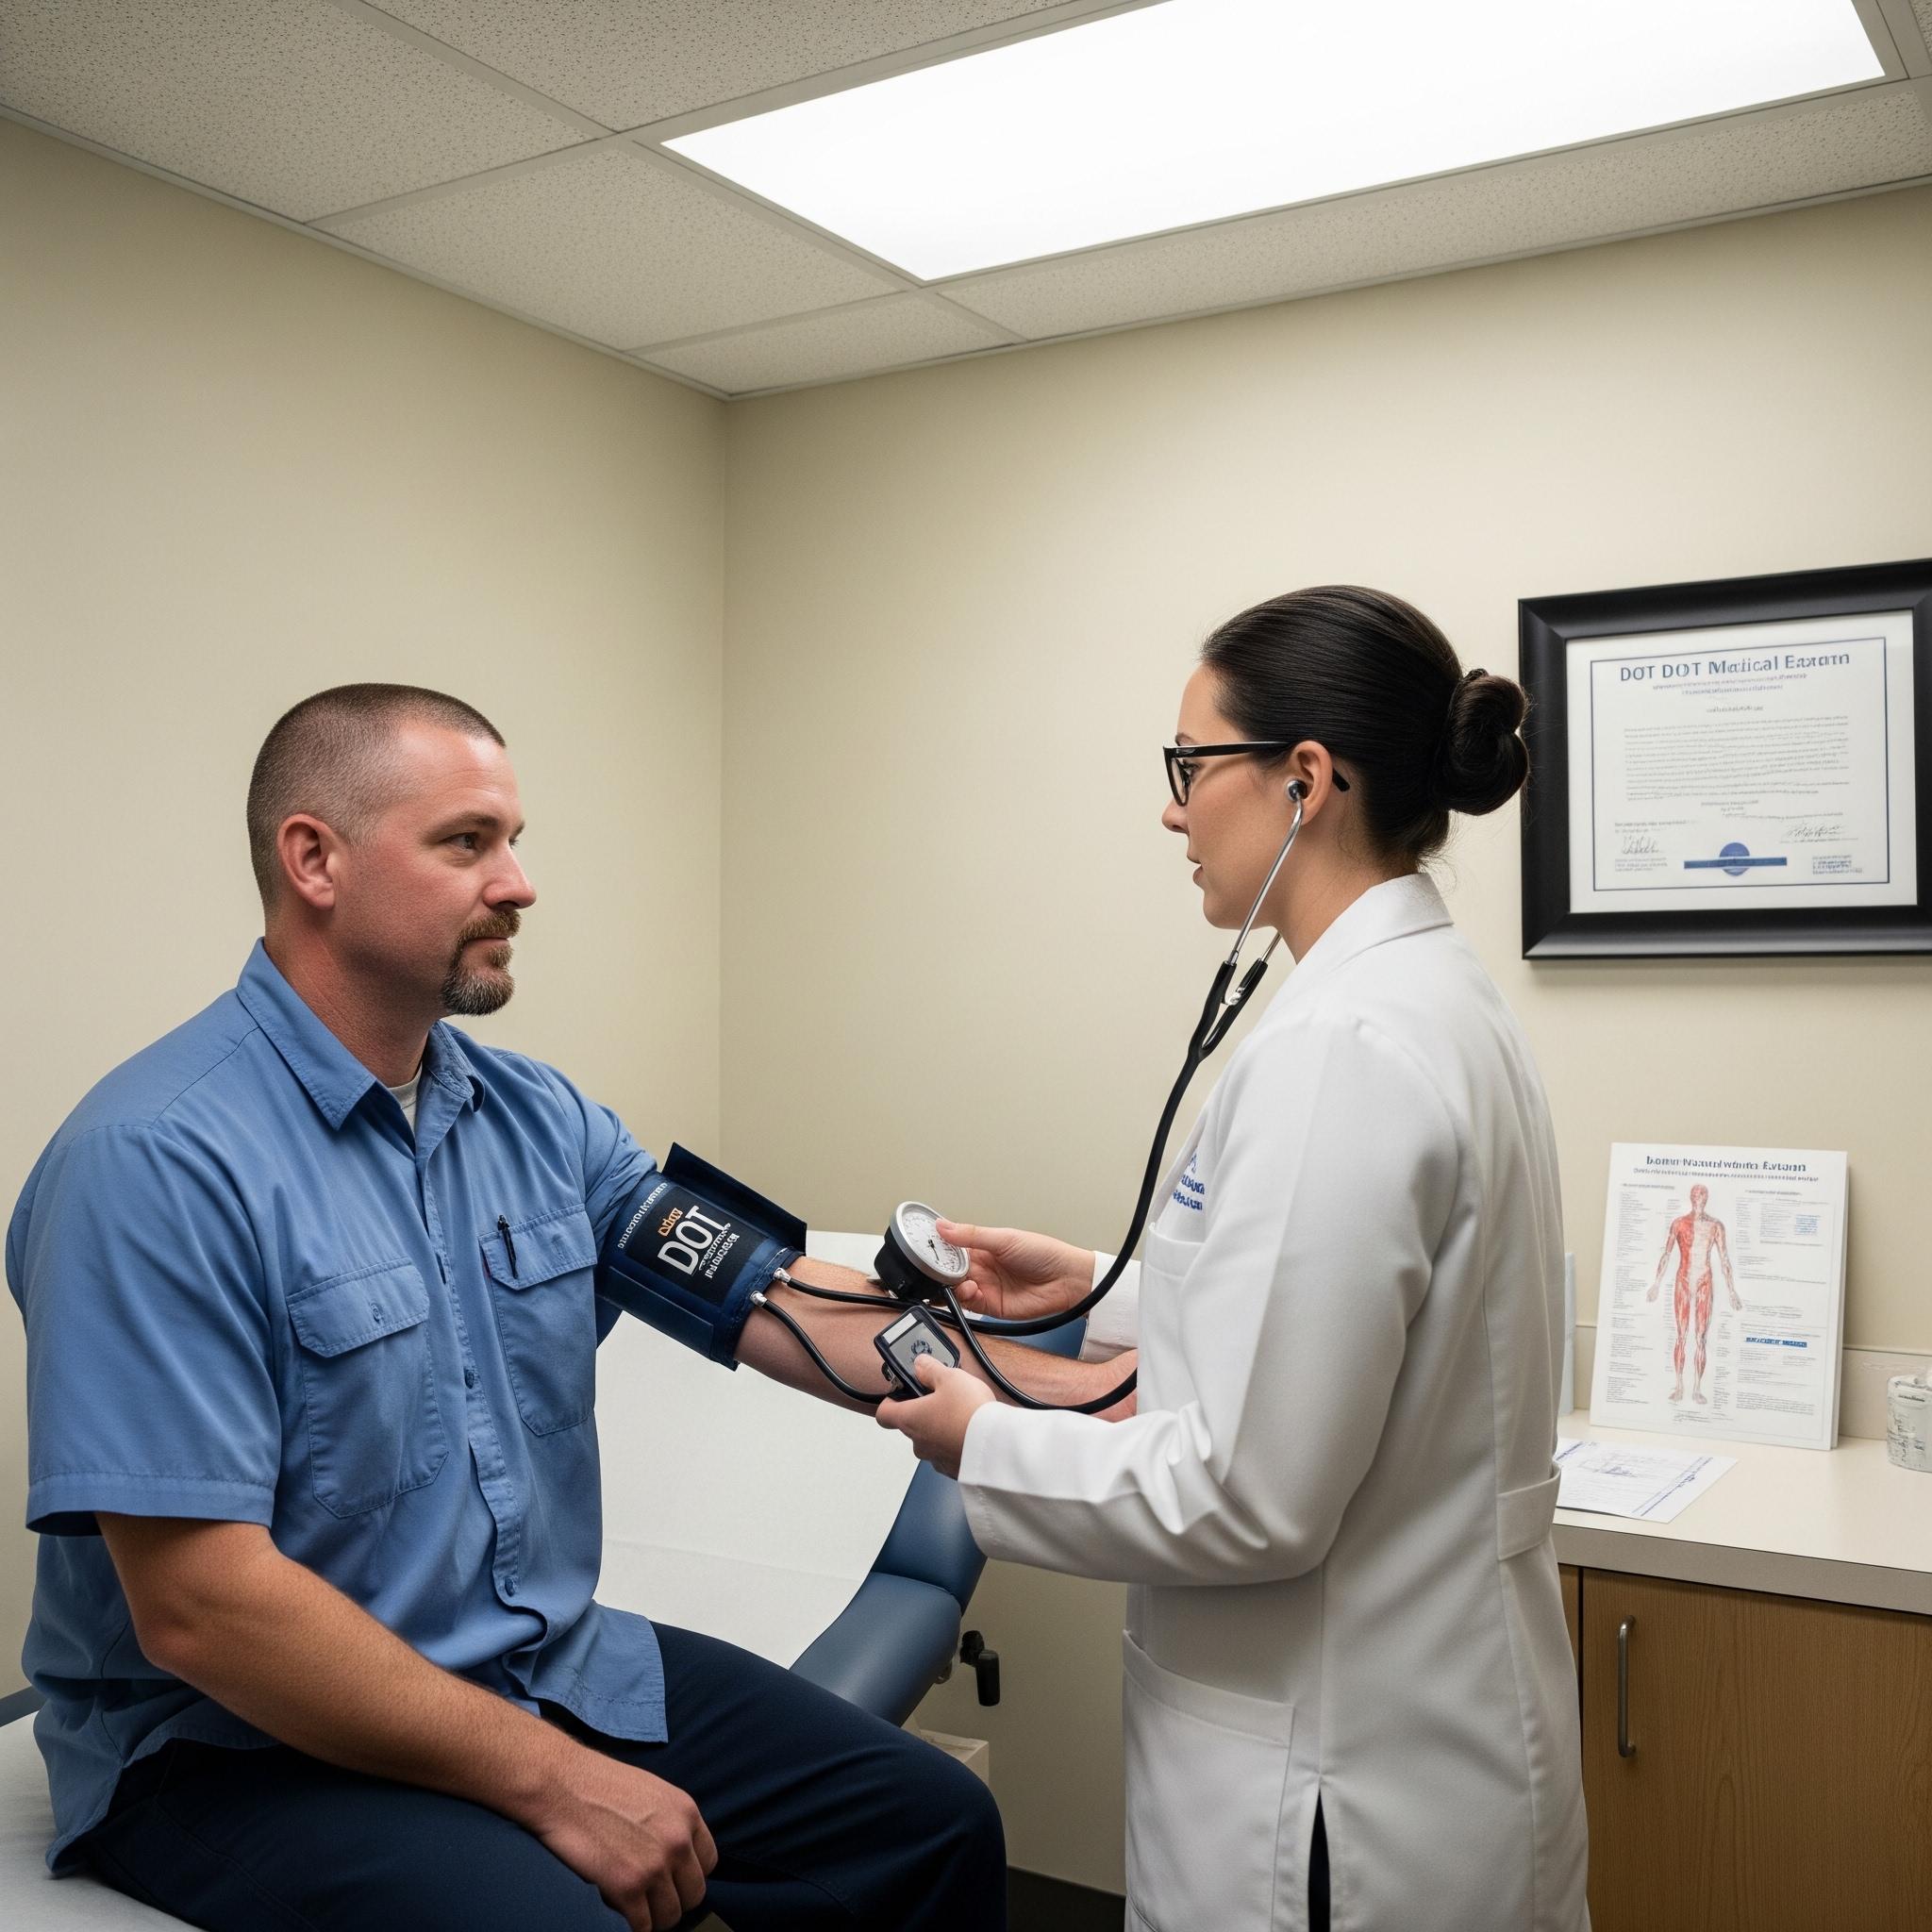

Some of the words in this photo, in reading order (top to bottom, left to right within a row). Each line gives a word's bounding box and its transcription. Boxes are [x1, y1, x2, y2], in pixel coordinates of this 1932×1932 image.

[1621, 665, 1655, 681] DOT
[1662, 662, 1702, 679] DOT
[658, 1205, 725, 1275] DOT
